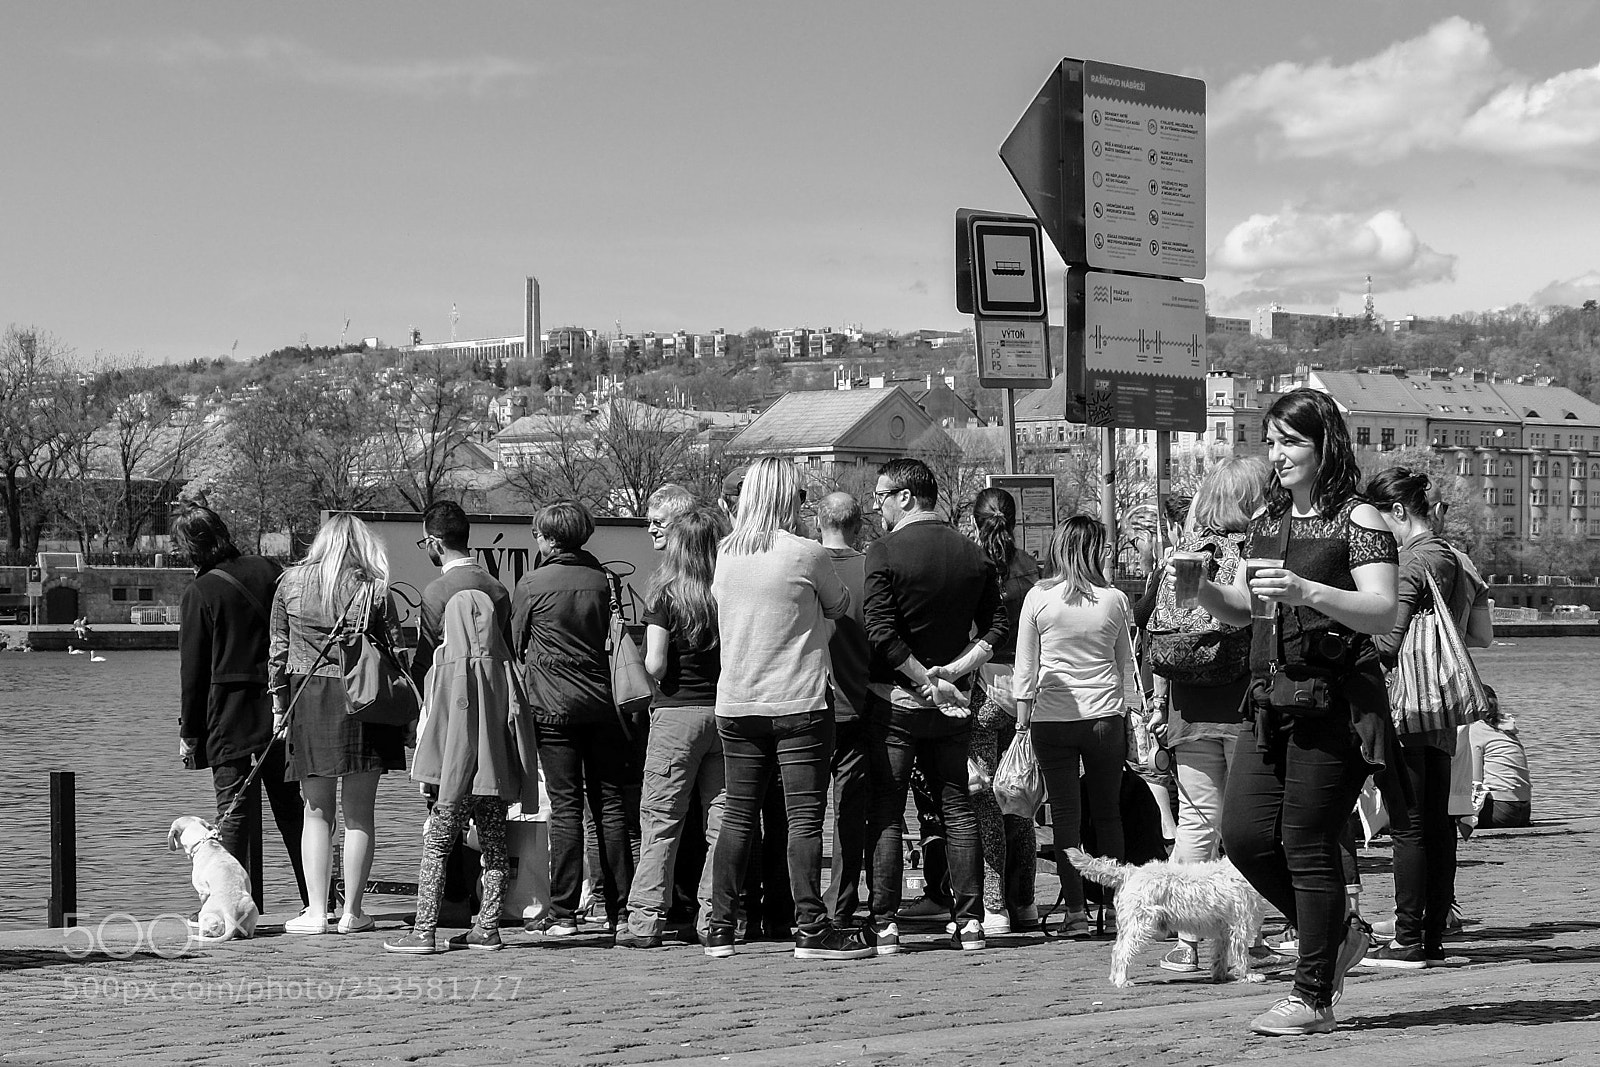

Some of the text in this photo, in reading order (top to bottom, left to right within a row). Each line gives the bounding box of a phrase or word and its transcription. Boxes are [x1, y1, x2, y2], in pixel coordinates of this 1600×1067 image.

[1001, 327, 1025, 339] VÝTOŇ
[991, 348, 1001, 359] P5
[991, 360, 1002, 371] P5
[31, 569, 38, 580] P
